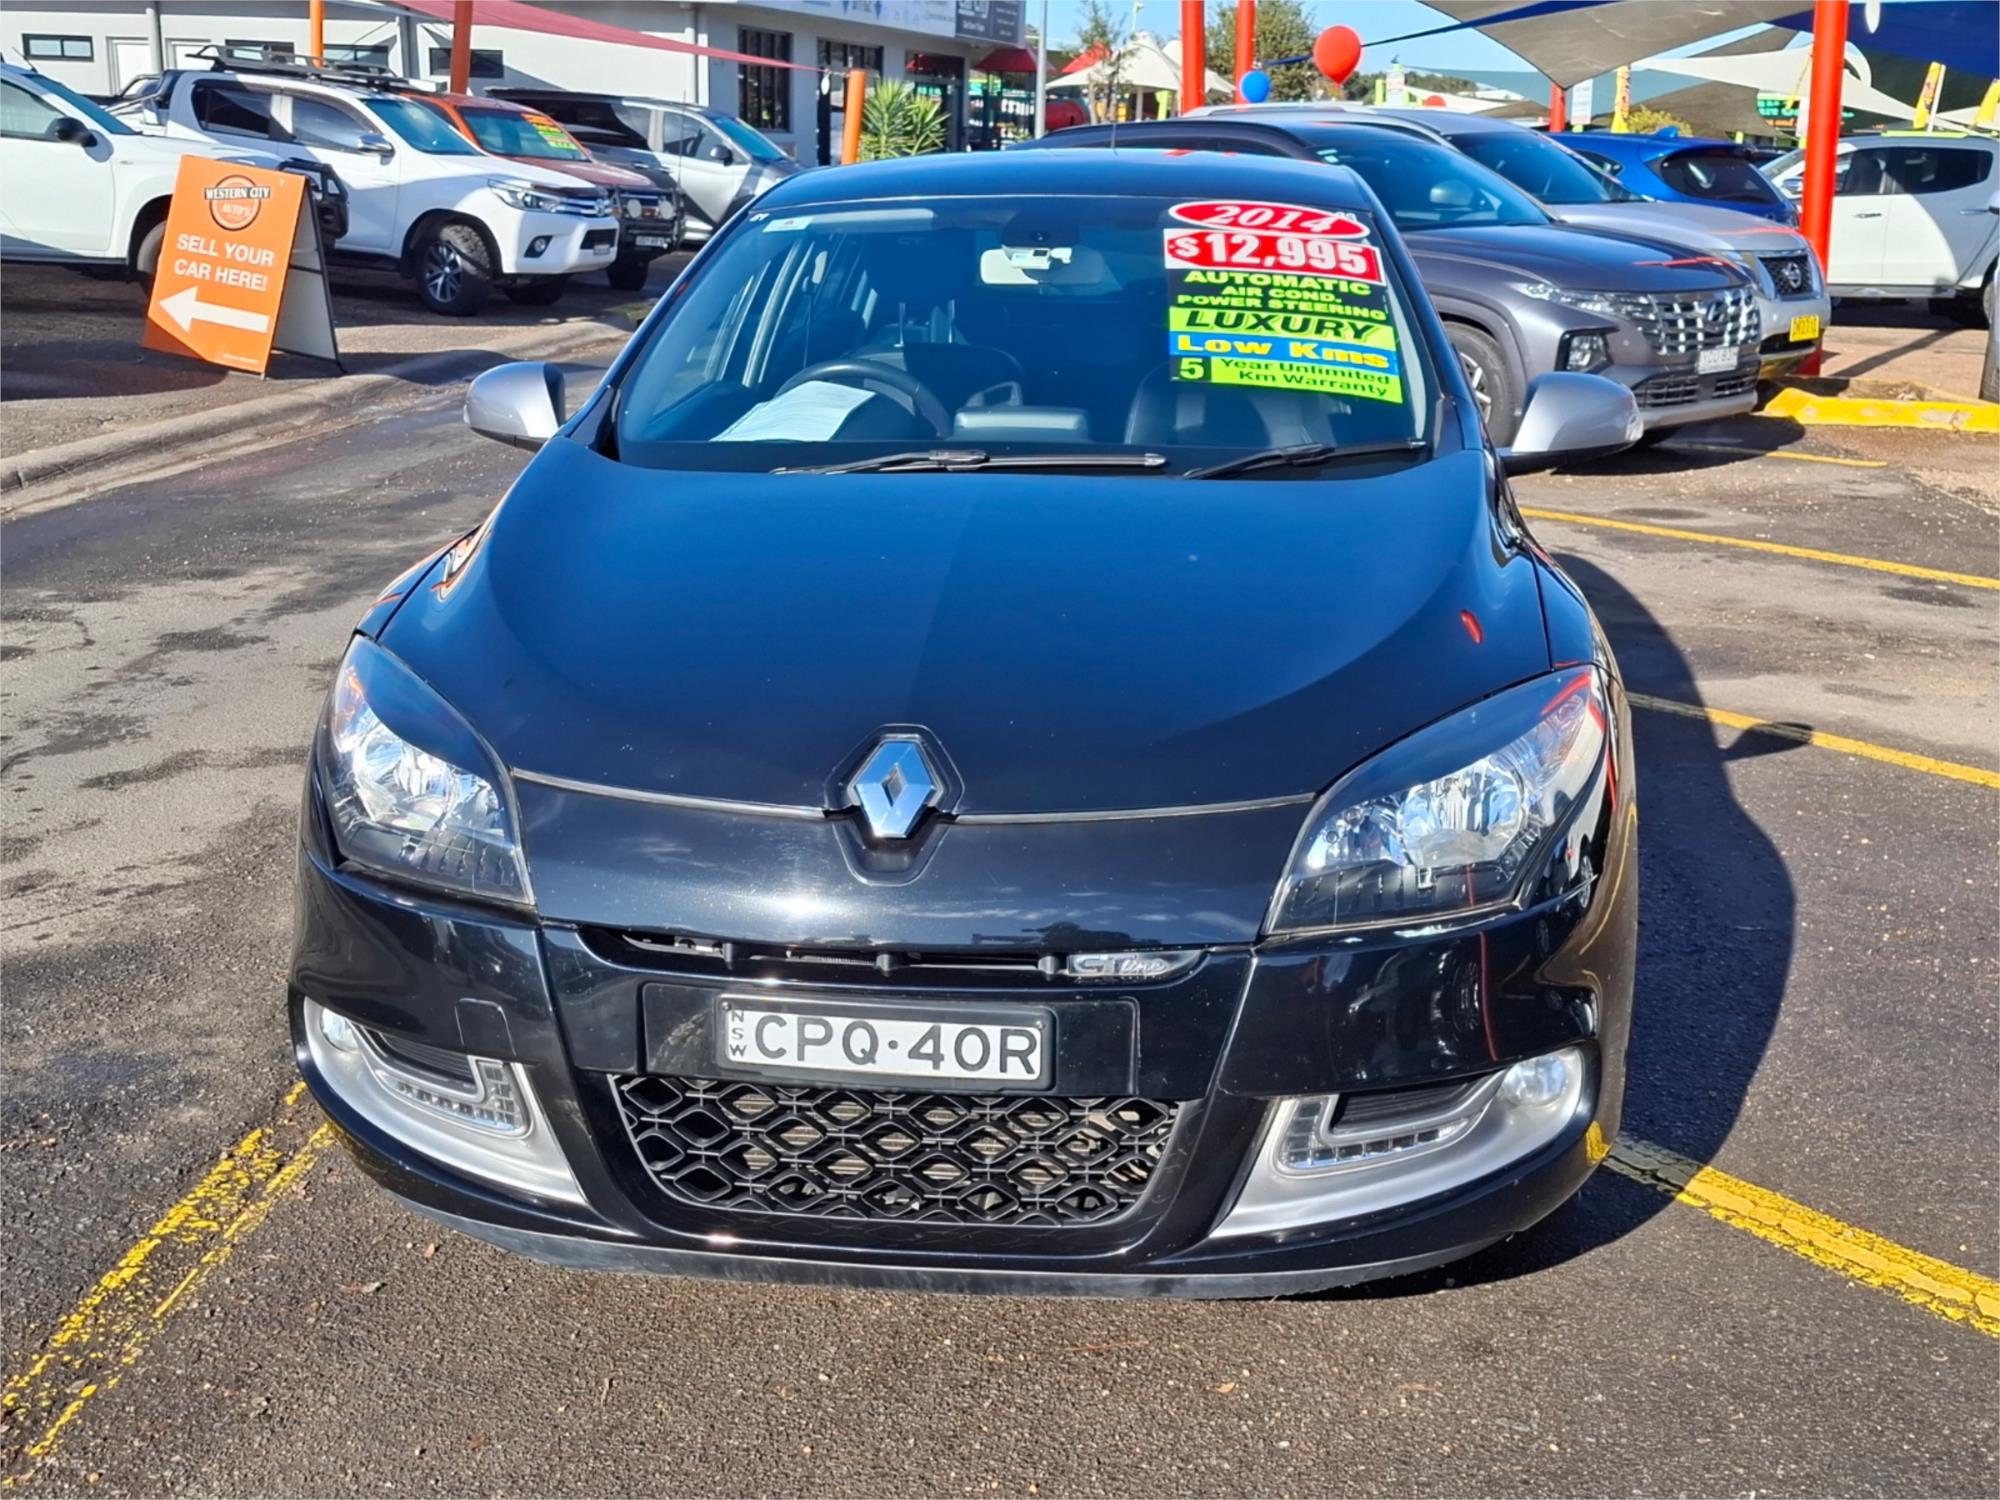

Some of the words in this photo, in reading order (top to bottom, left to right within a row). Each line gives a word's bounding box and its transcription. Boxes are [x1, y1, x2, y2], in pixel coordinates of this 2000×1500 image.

[206, 187, 247, 199] WESTERN
[249, 187, 270, 198] CITY
[1202, 206, 1336, 232] 2014
[176, 233, 219, 257] SELL
[224, 242, 275, 267] YOUR
[1174, 233, 1368, 275] $12,995
[174, 259, 211, 280] CAR
[214, 266, 268, 291] HERE!
[1183, 270, 1372, 296] AUTOMATIC
[1220, 285, 1263, 297] AIR
[1268, 288, 1343, 303] COND.
[1177, 295, 1263, 308] POWER
[1267, 300, 1387, 321] STEERING
[1185, 310, 1374, 340] LUXURY
[1177, 335, 1273, 355] Low
[1289, 341, 1389, 369] Kms
[1180, 357, 1205, 379] 5
[1220, 358, 1271, 371] Year
[1278, 361, 1391, 386] Unlimited
[1239, 371, 1276, 384] Km
[1283, 374, 1388, 397] Warranty
